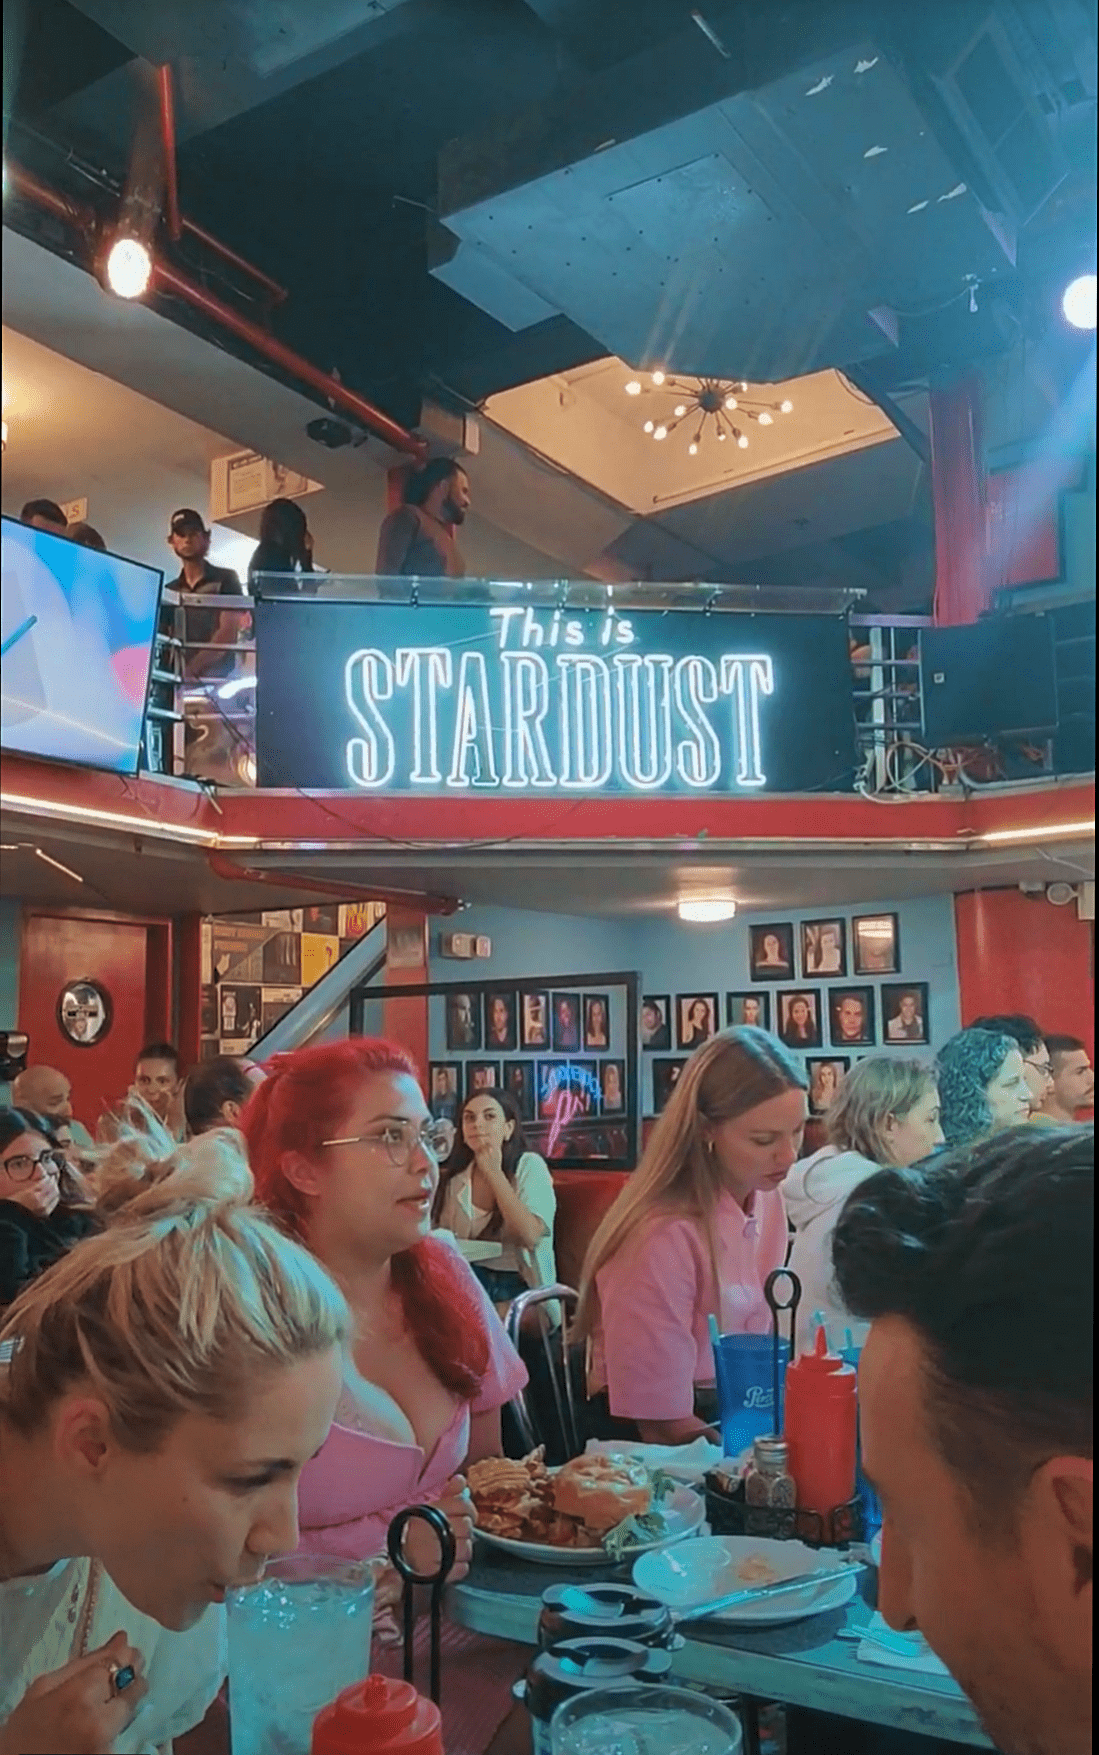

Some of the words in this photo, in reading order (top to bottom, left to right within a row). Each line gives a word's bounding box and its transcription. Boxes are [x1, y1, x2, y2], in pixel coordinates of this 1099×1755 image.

[489, 606, 584, 648] This
[602, 605, 635, 646] is
[345, 647, 774, 788] STARDUST
